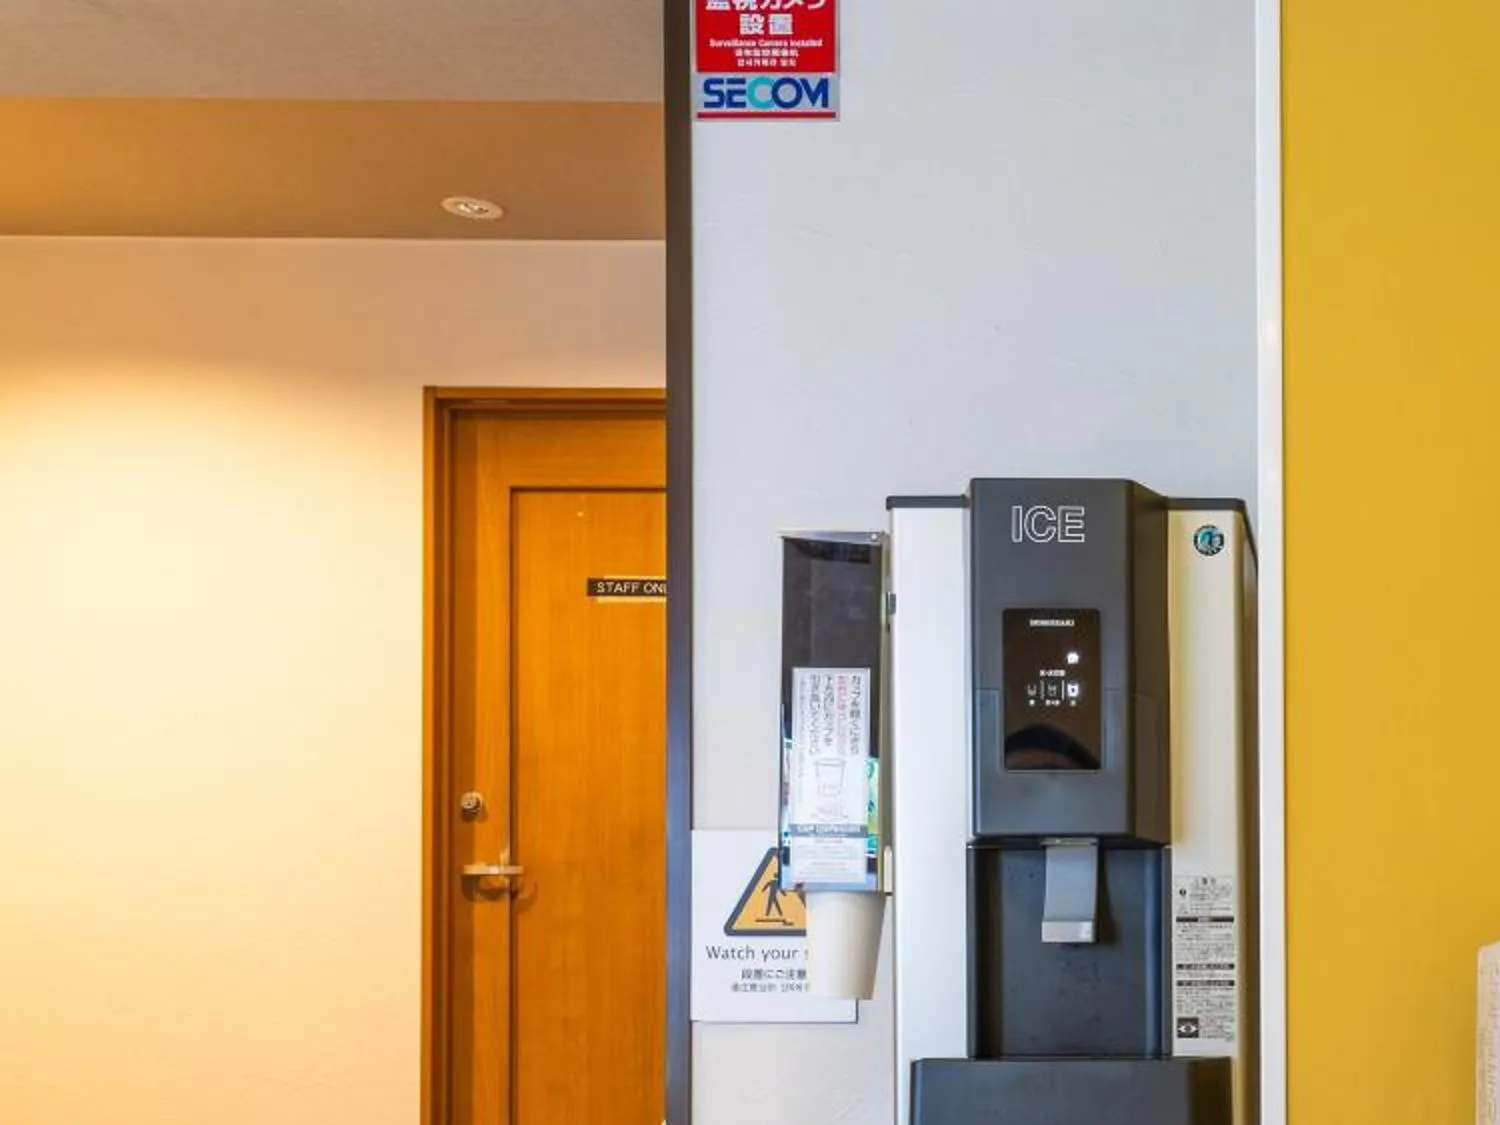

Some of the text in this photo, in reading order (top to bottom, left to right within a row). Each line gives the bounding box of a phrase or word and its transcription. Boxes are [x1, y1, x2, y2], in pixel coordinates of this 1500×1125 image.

[703, 77, 829, 110] SECOM
[1011, 505, 1085, 543] ICE
[596, 581, 640, 593] STAFF
[705, 944, 755, 960] Watch
[761, 949, 799, 963] your
